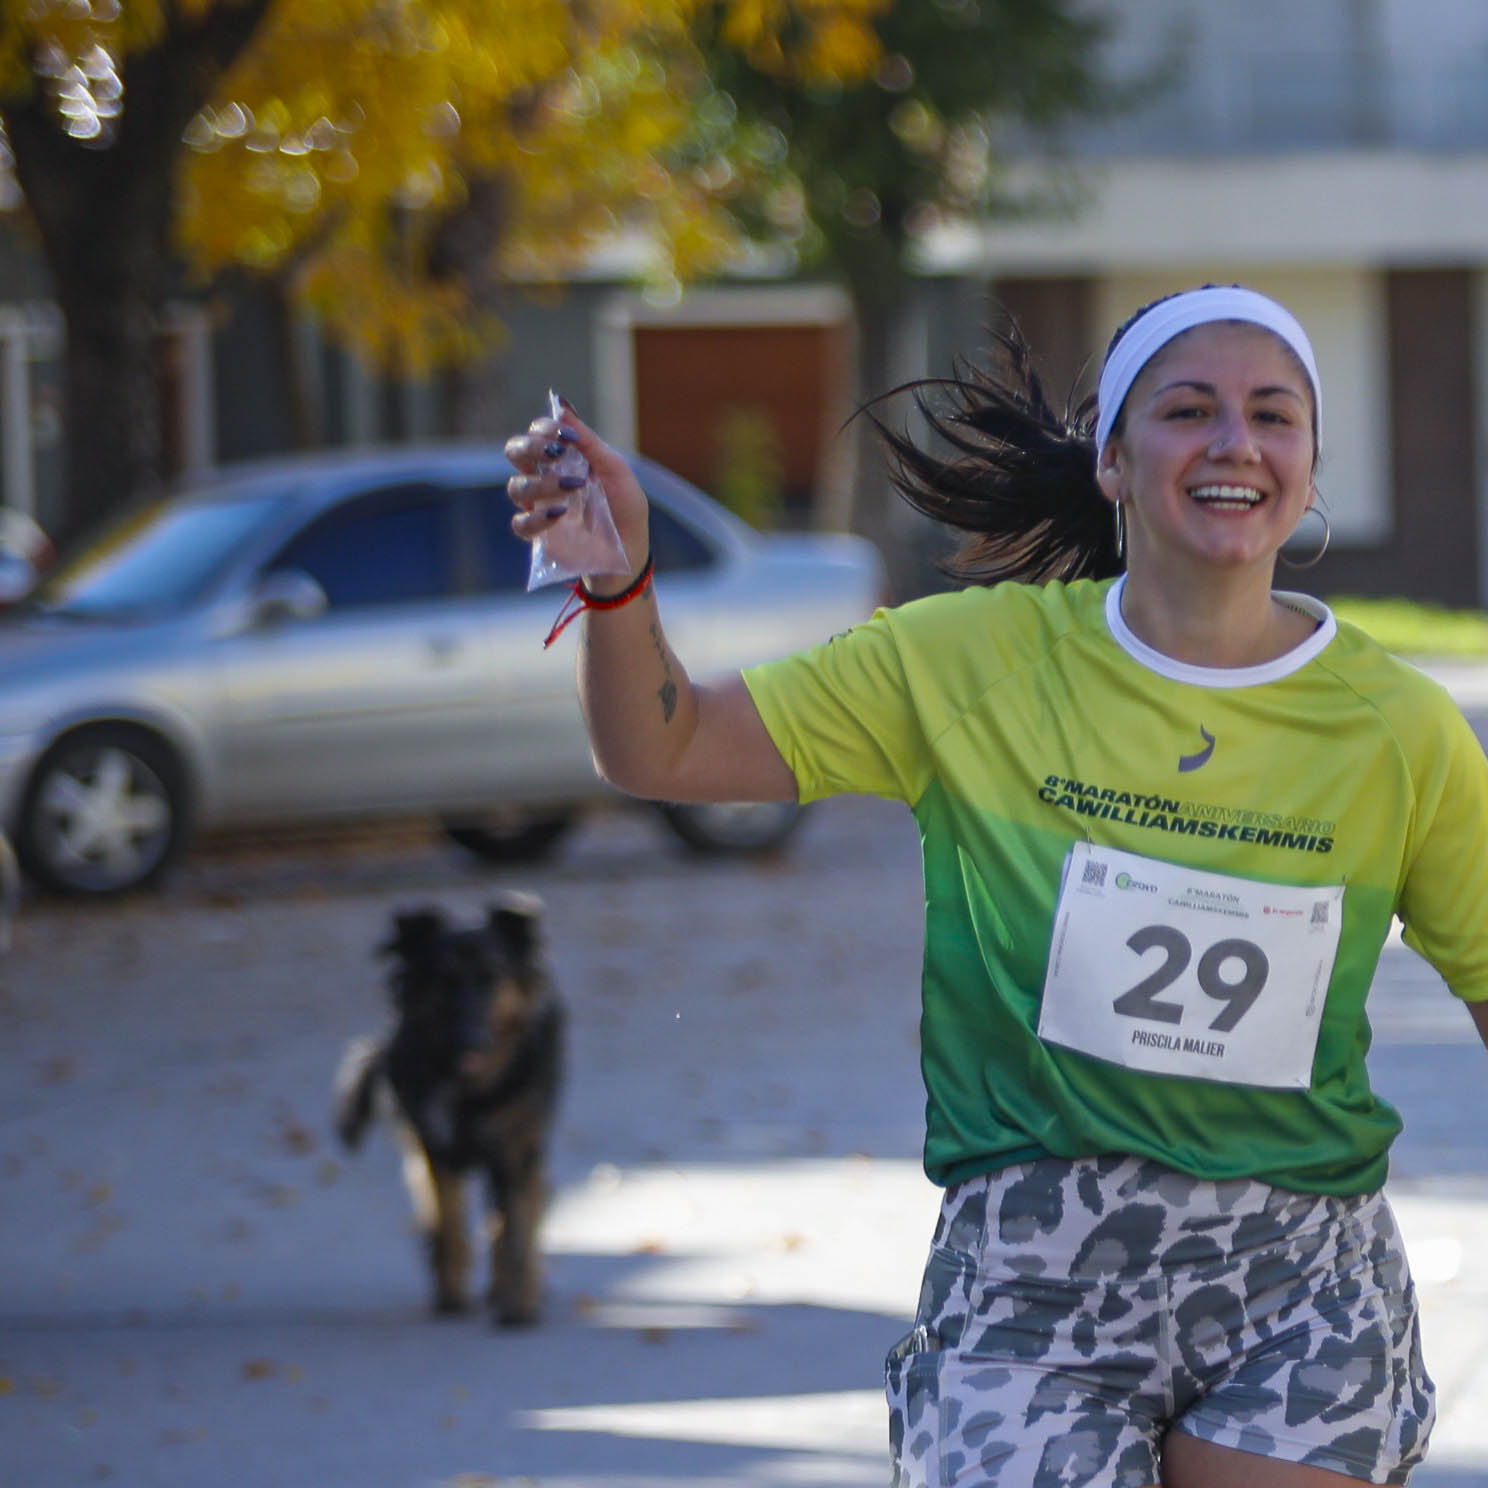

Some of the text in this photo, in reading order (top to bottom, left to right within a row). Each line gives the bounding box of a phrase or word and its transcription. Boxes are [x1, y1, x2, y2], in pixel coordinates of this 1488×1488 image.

[1038, 787, 1334, 853] CAWILLIAMSKEMMIS
[1112, 924, 1270, 1033] 29
[1132, 1029, 1225, 1058] PRISCILA MALIER
